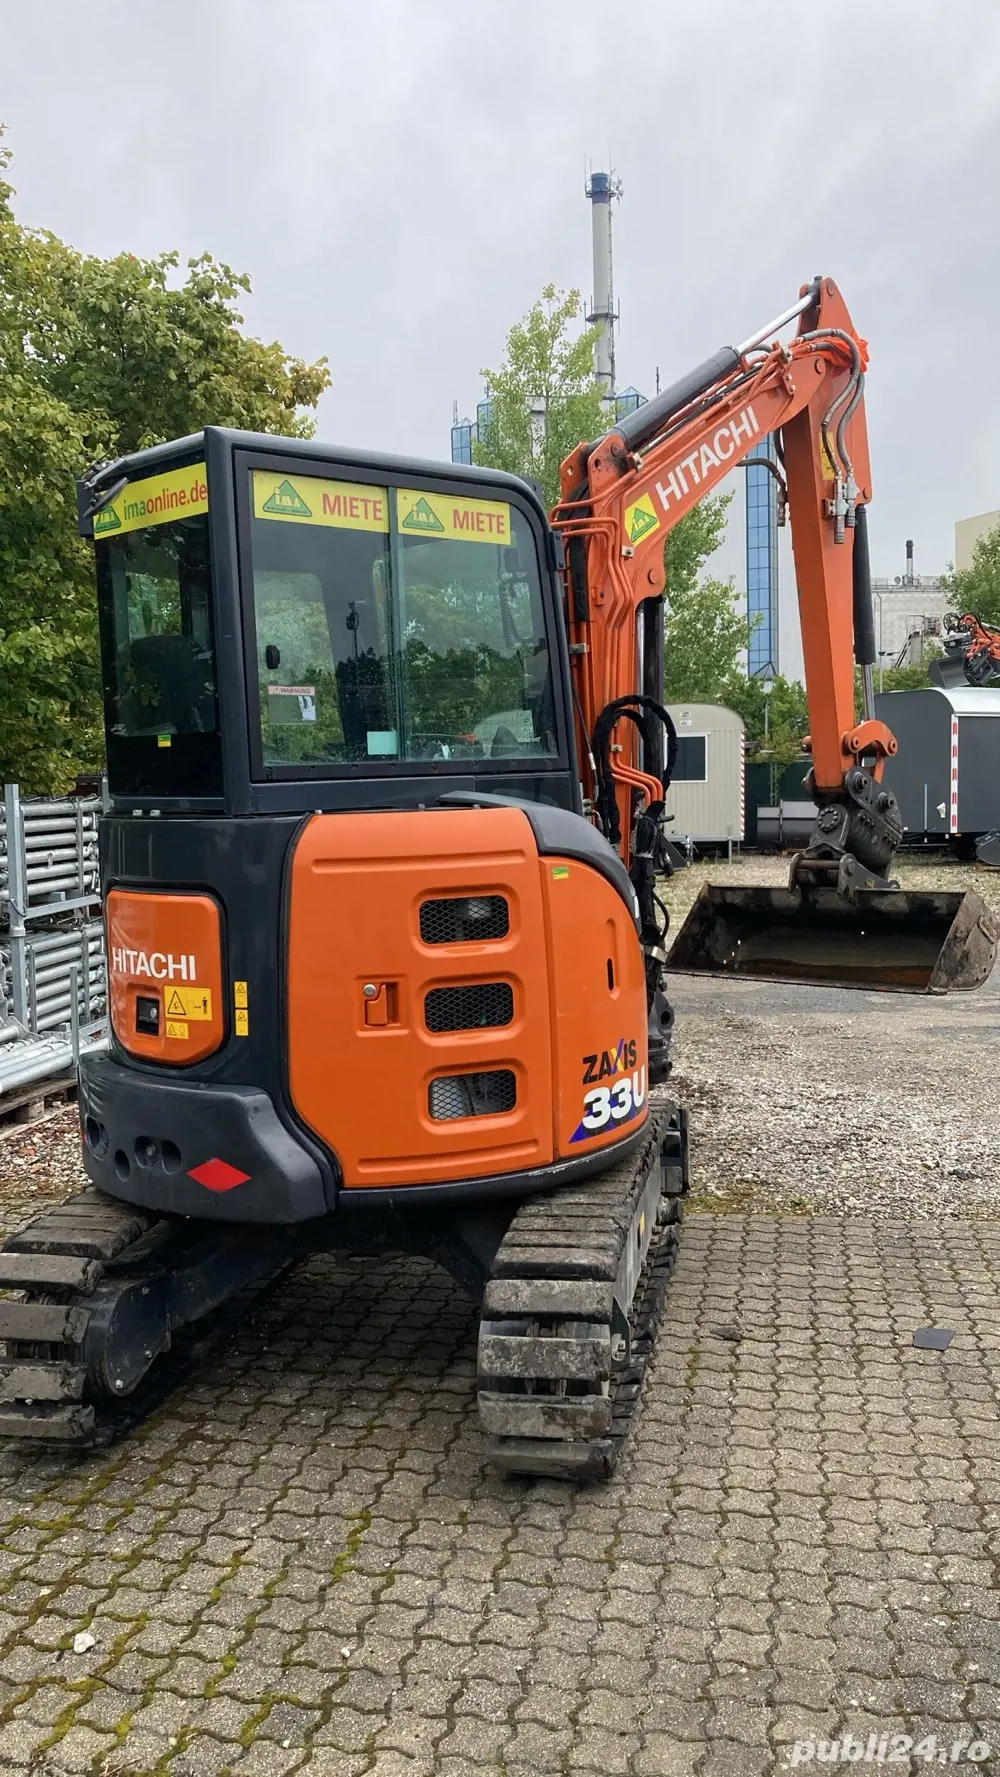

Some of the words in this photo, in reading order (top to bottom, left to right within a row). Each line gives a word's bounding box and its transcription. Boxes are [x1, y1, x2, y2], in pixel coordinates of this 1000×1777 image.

[655, 405, 760, 512] HITACHI
[123, 480, 208, 520] imaonline.de
[322, 493, 383, 521] MIETE
[452, 509, 505, 535] MIETE
[112, 947, 196, 980] HITACHI
[582, 1037, 637, 1085] ZAXIS
[582, 1064, 646, 1129] 33U
